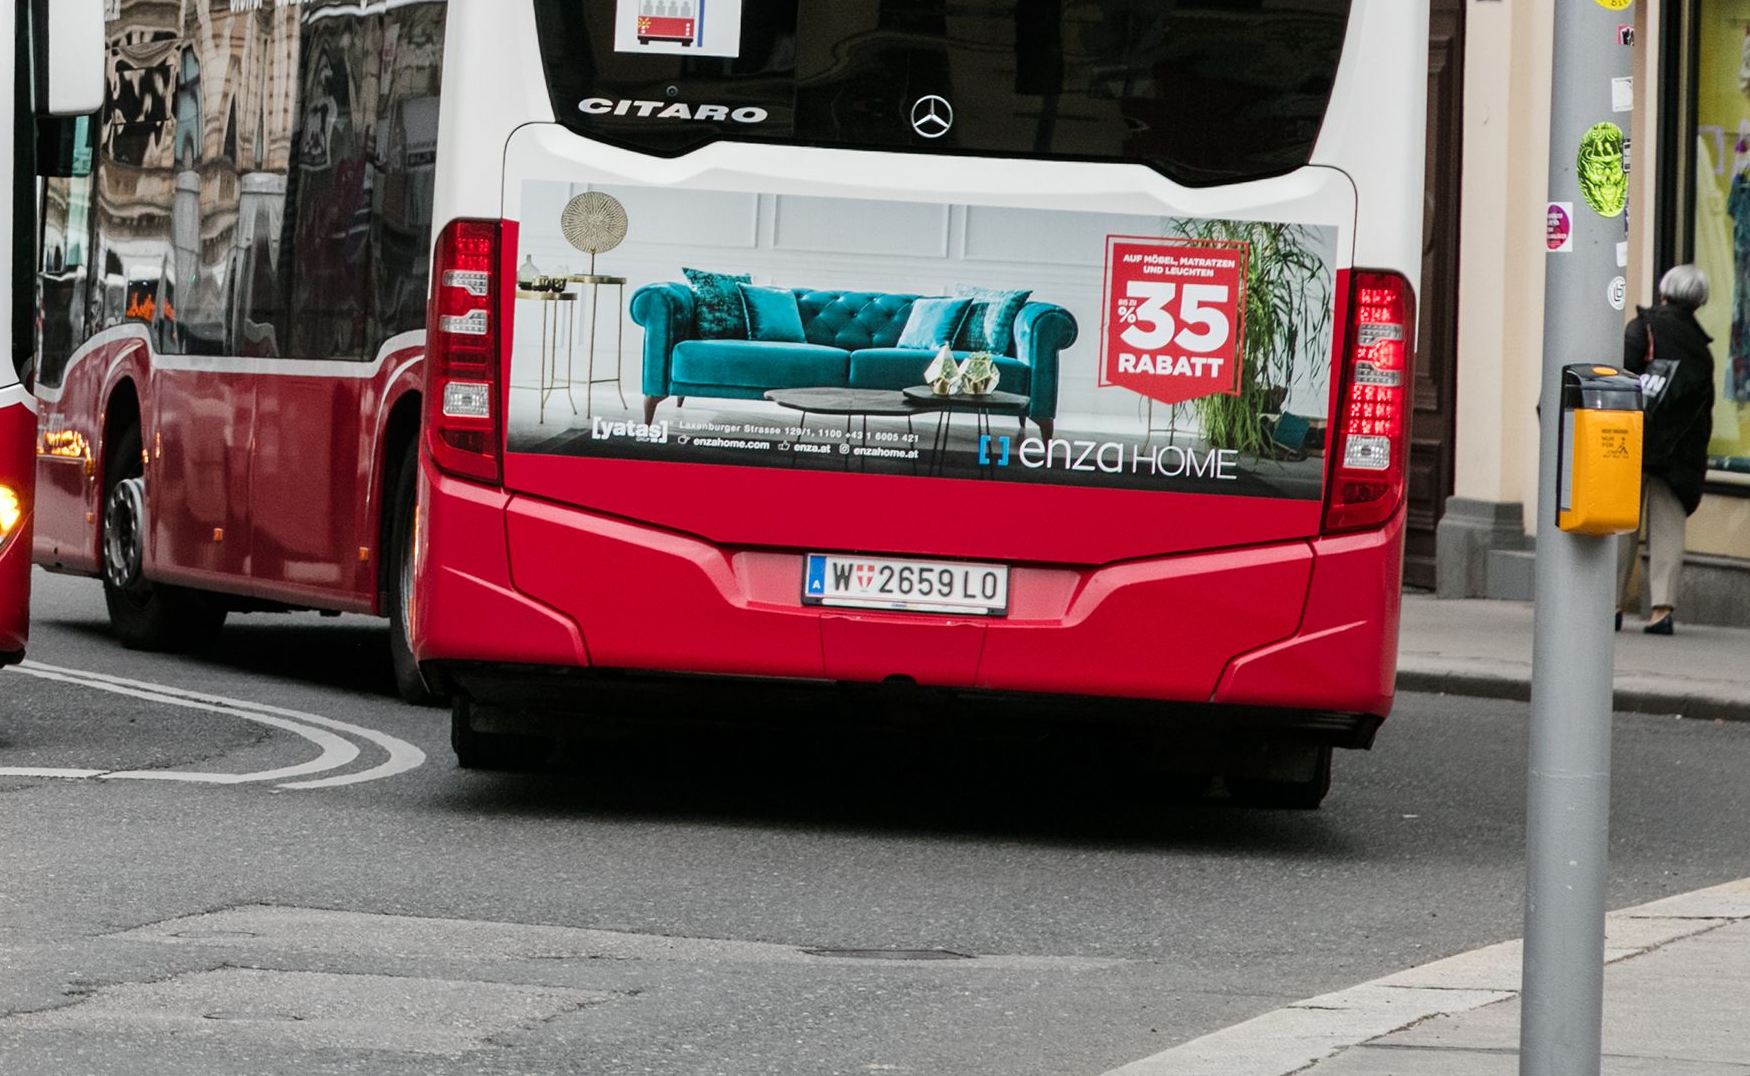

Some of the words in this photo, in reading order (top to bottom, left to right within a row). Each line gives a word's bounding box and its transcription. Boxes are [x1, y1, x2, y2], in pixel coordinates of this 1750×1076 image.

[578, 97, 768, 123] CITARO
[1123, 254, 1143, 263] AUF
[1144, 254, 1178, 266] MÖBEL,
[1180, 257, 1235, 268] MATRATZEN
[1143, 265, 1164, 274] UND
[1165, 267, 1214, 277] LEUCHTEN
[1120, 280, 1230, 353] 35
[1118, 353, 1224, 378] RABATT
[678, 421, 741, 435] Laxenburger
[744, 424, 780, 435] Strasse
[818, 429, 842, 439] 1100
[902, 434, 919, 443] 421
[693, 437, 770, 450] enzahome.com
[793, 443, 831, 454] enza.at
[853, 447, 919, 459] enzahome.at
[1019, 436, 1123, 474] enza
[1132, 443, 1239, 480] HOME
